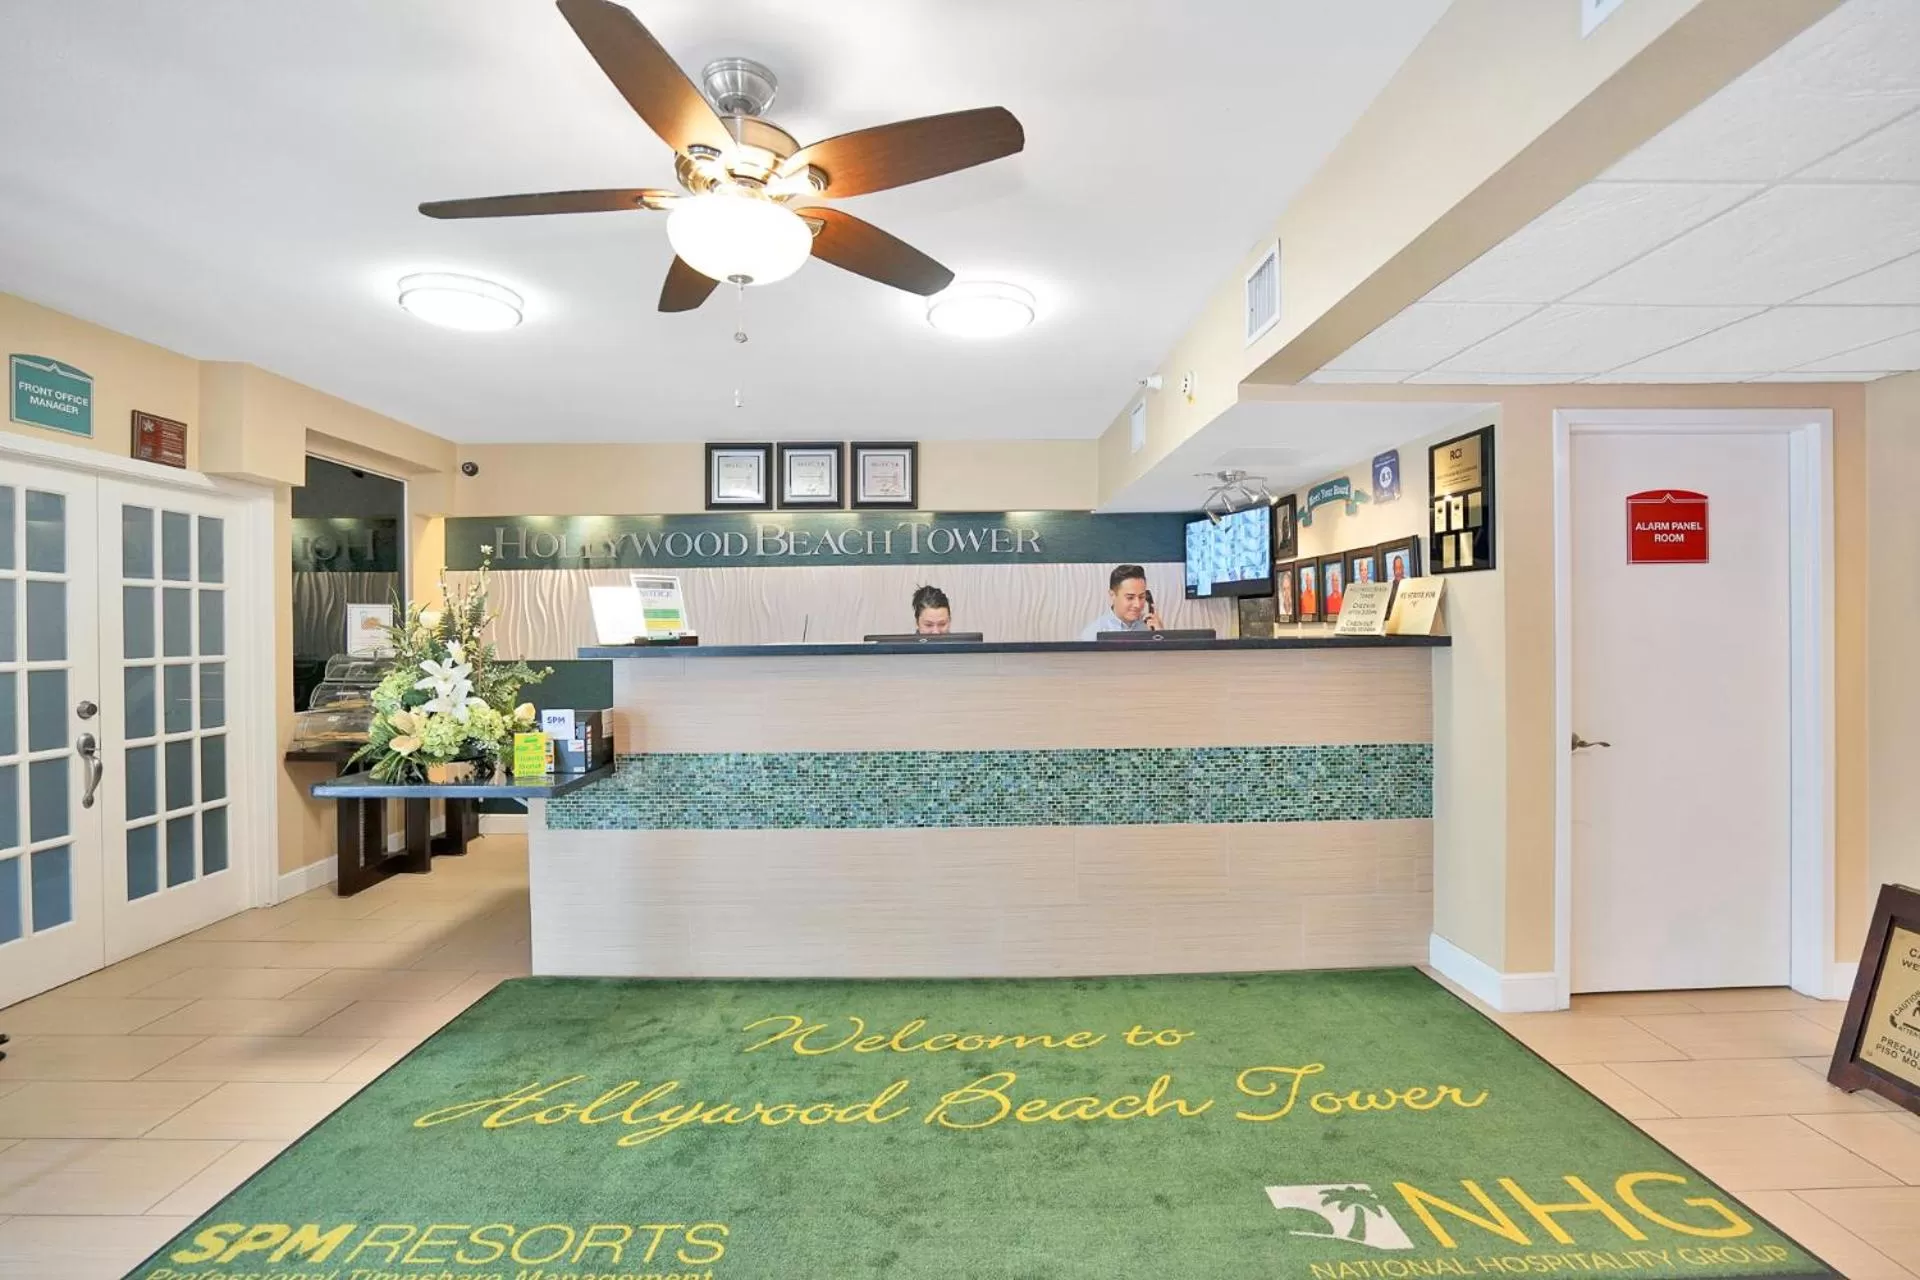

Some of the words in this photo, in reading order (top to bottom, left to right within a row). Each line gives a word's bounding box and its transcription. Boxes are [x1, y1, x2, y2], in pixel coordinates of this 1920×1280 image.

[18, 381, 53, 398] FRONT
[54, 390, 89, 407] OFFICE
[29, 395, 79, 416] MANAGER
[495, 525, 749, 560] HOLLYWOOD
[755, 522, 893, 557] BEACH
[898, 521, 1041, 555] TOWER
[1635, 521, 1670, 531] ALARM
[1671, 521, 1704, 531] PANEL
[1654, 533, 1685, 543] ROOM
[743, 1015, 1107, 1056] Welcome
[1122, 1024, 1195, 1048] to
[1876, 1043, 1898, 1058] PISO
[413, 1075, 911, 1147] Hollywood
[924, 1071, 1215, 1128] Beach
[1234, 1063, 1490, 1121] Tower
[1392, 1170, 1755, 1250] NHG
[344, 1222, 730, 1265] RESORTS
[1308, 1257, 1477, 1280] NATIONAL
[1473, 1249, 1677, 1275] HOSPITALITY
[1677, 1244, 1789, 1264] GROUP
